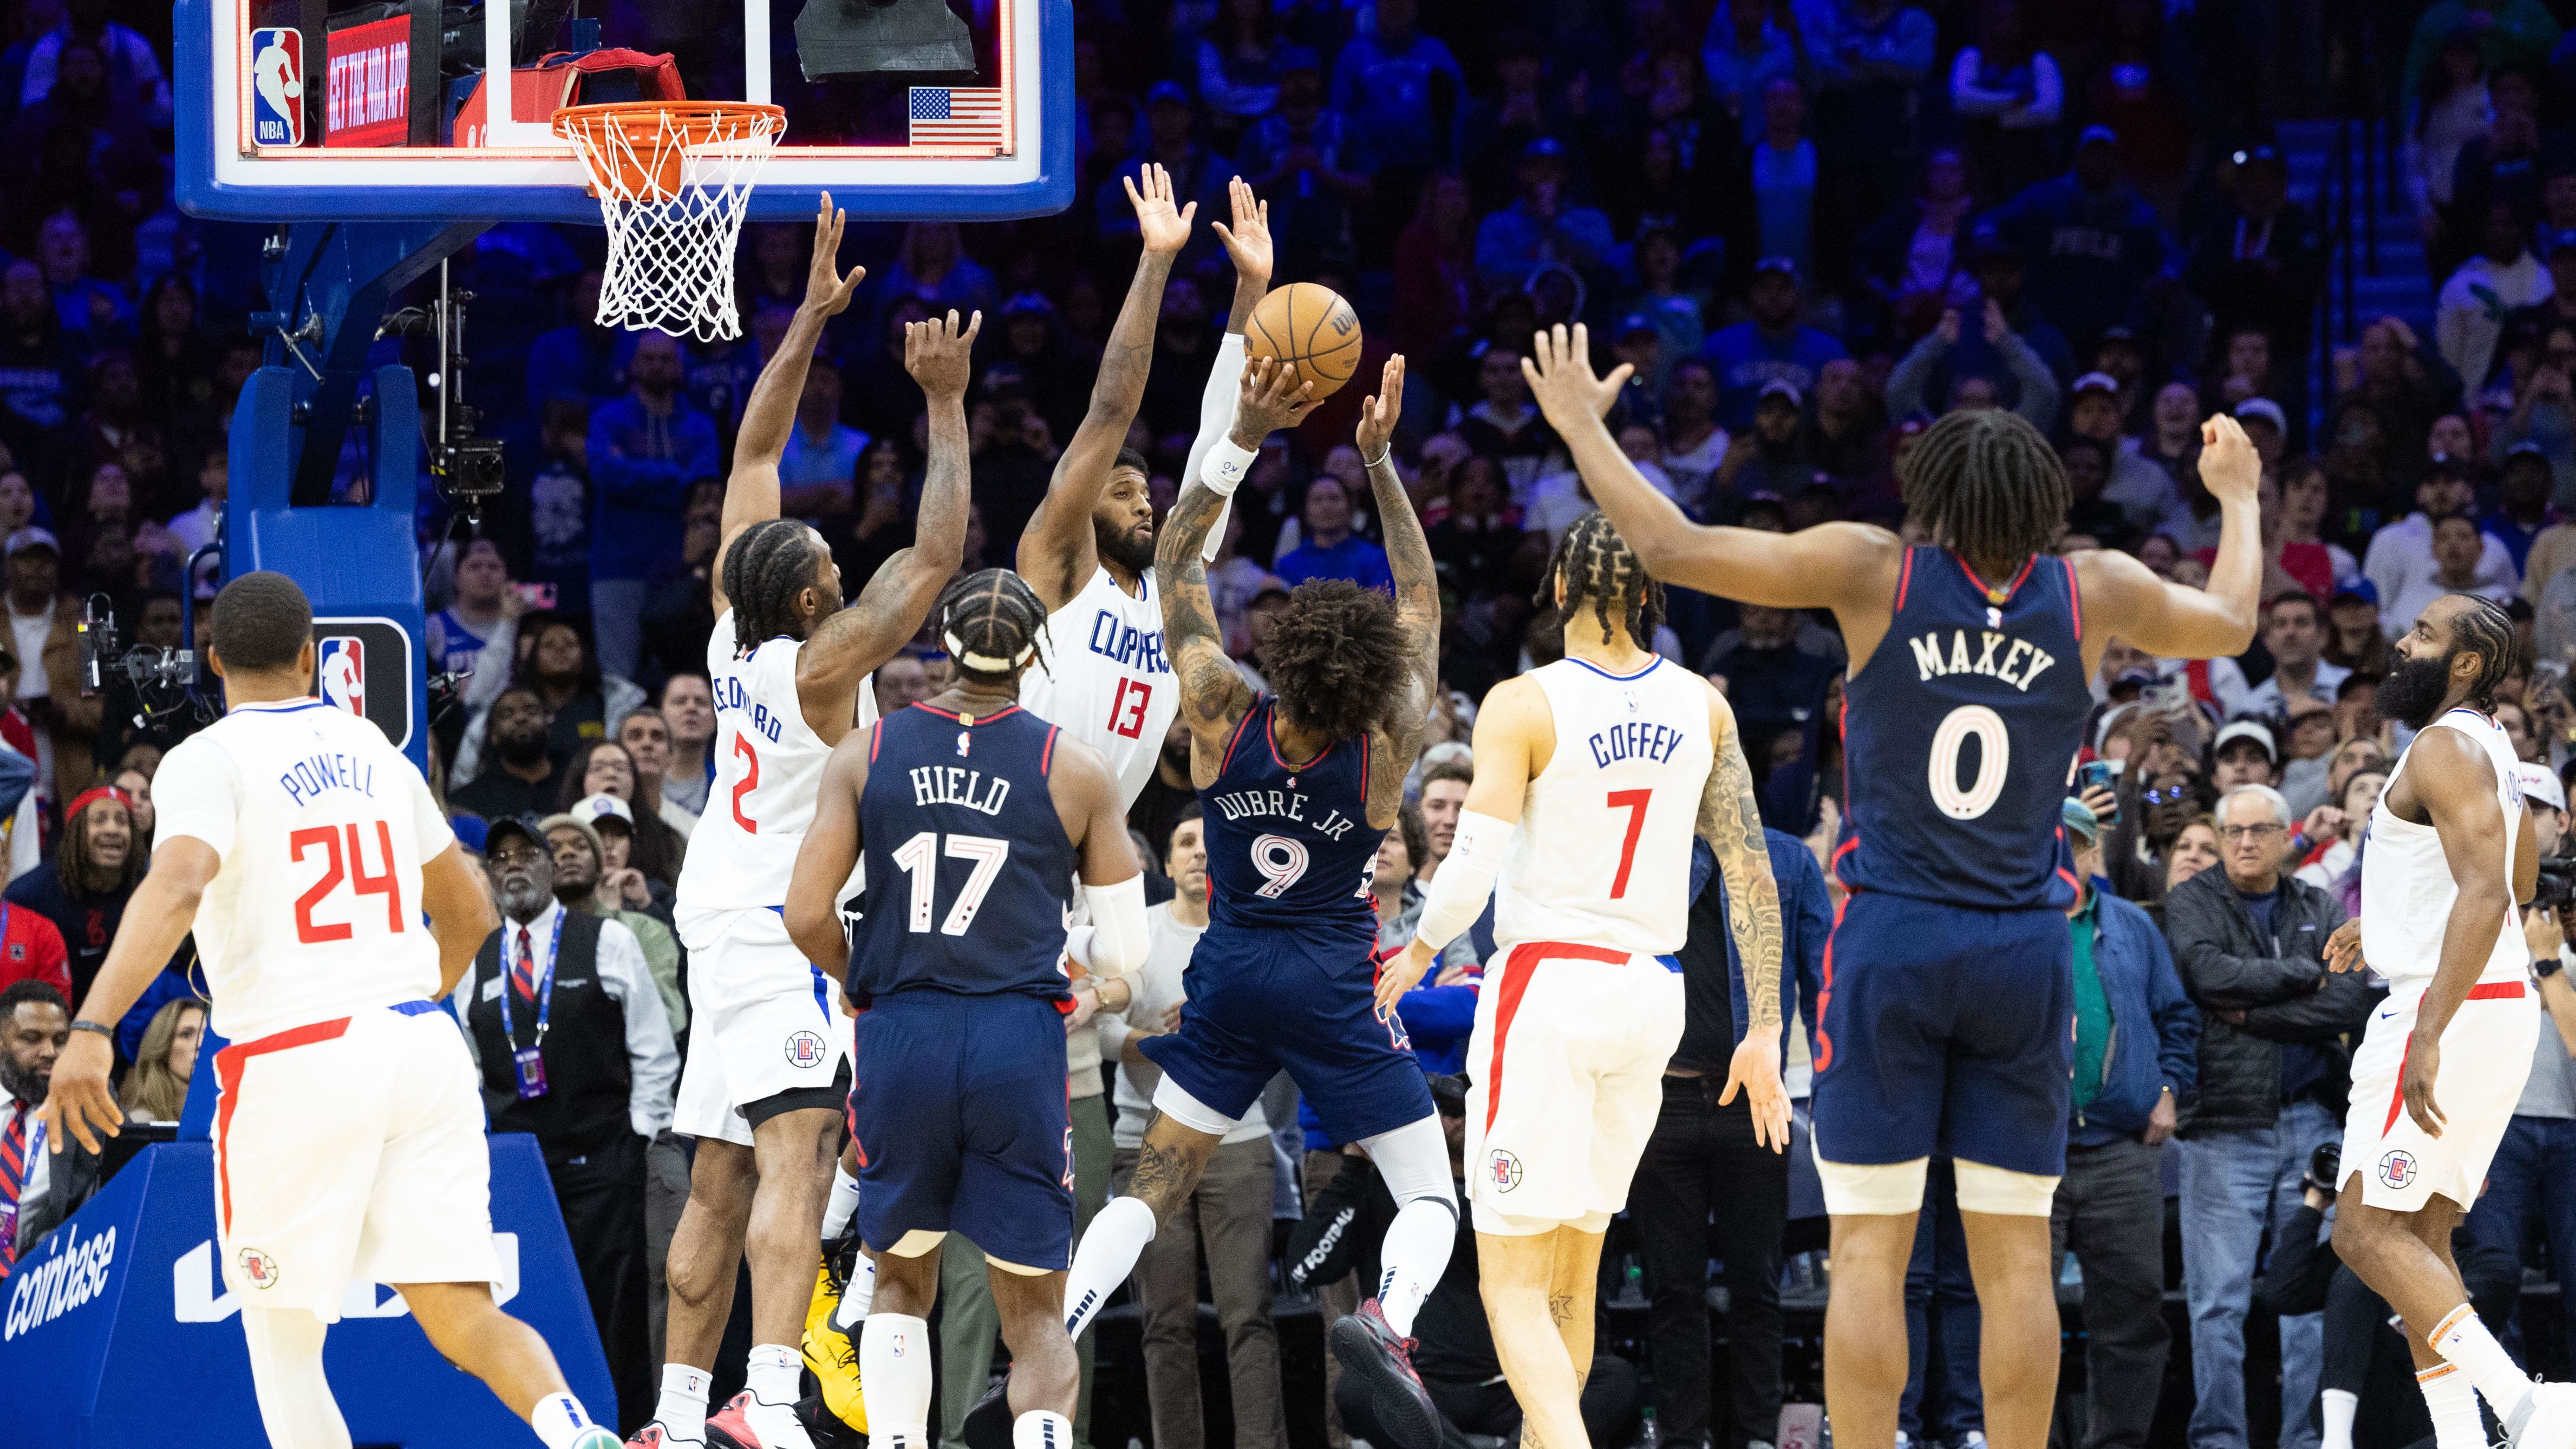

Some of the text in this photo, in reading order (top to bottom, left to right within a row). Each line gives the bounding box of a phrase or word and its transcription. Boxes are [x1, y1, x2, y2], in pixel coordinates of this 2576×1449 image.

[329, 41, 408, 133] GET THE NBA APP
[259, 120, 284, 140] NBA
[1909, 629, 2056, 692] MAXEY
[1107, 677, 1152, 740] 13
[1588, 722, 1684, 769] COFFEY
[1928, 704, 2010, 821] 0
[279, 753, 374, 807] POWELL
[733, 730, 759, 835] 2
[909, 765, 1011, 816] HIELD
[1250, 833, 1309, 899] 9
[1607, 788, 1653, 900] 7
[290, 820, 405, 944] 24
[891, 831, 1010, 937] 17
[1303, 1207, 1356, 1270] FOOTBALL
[4, 1223, 116, 1342] coinbase
